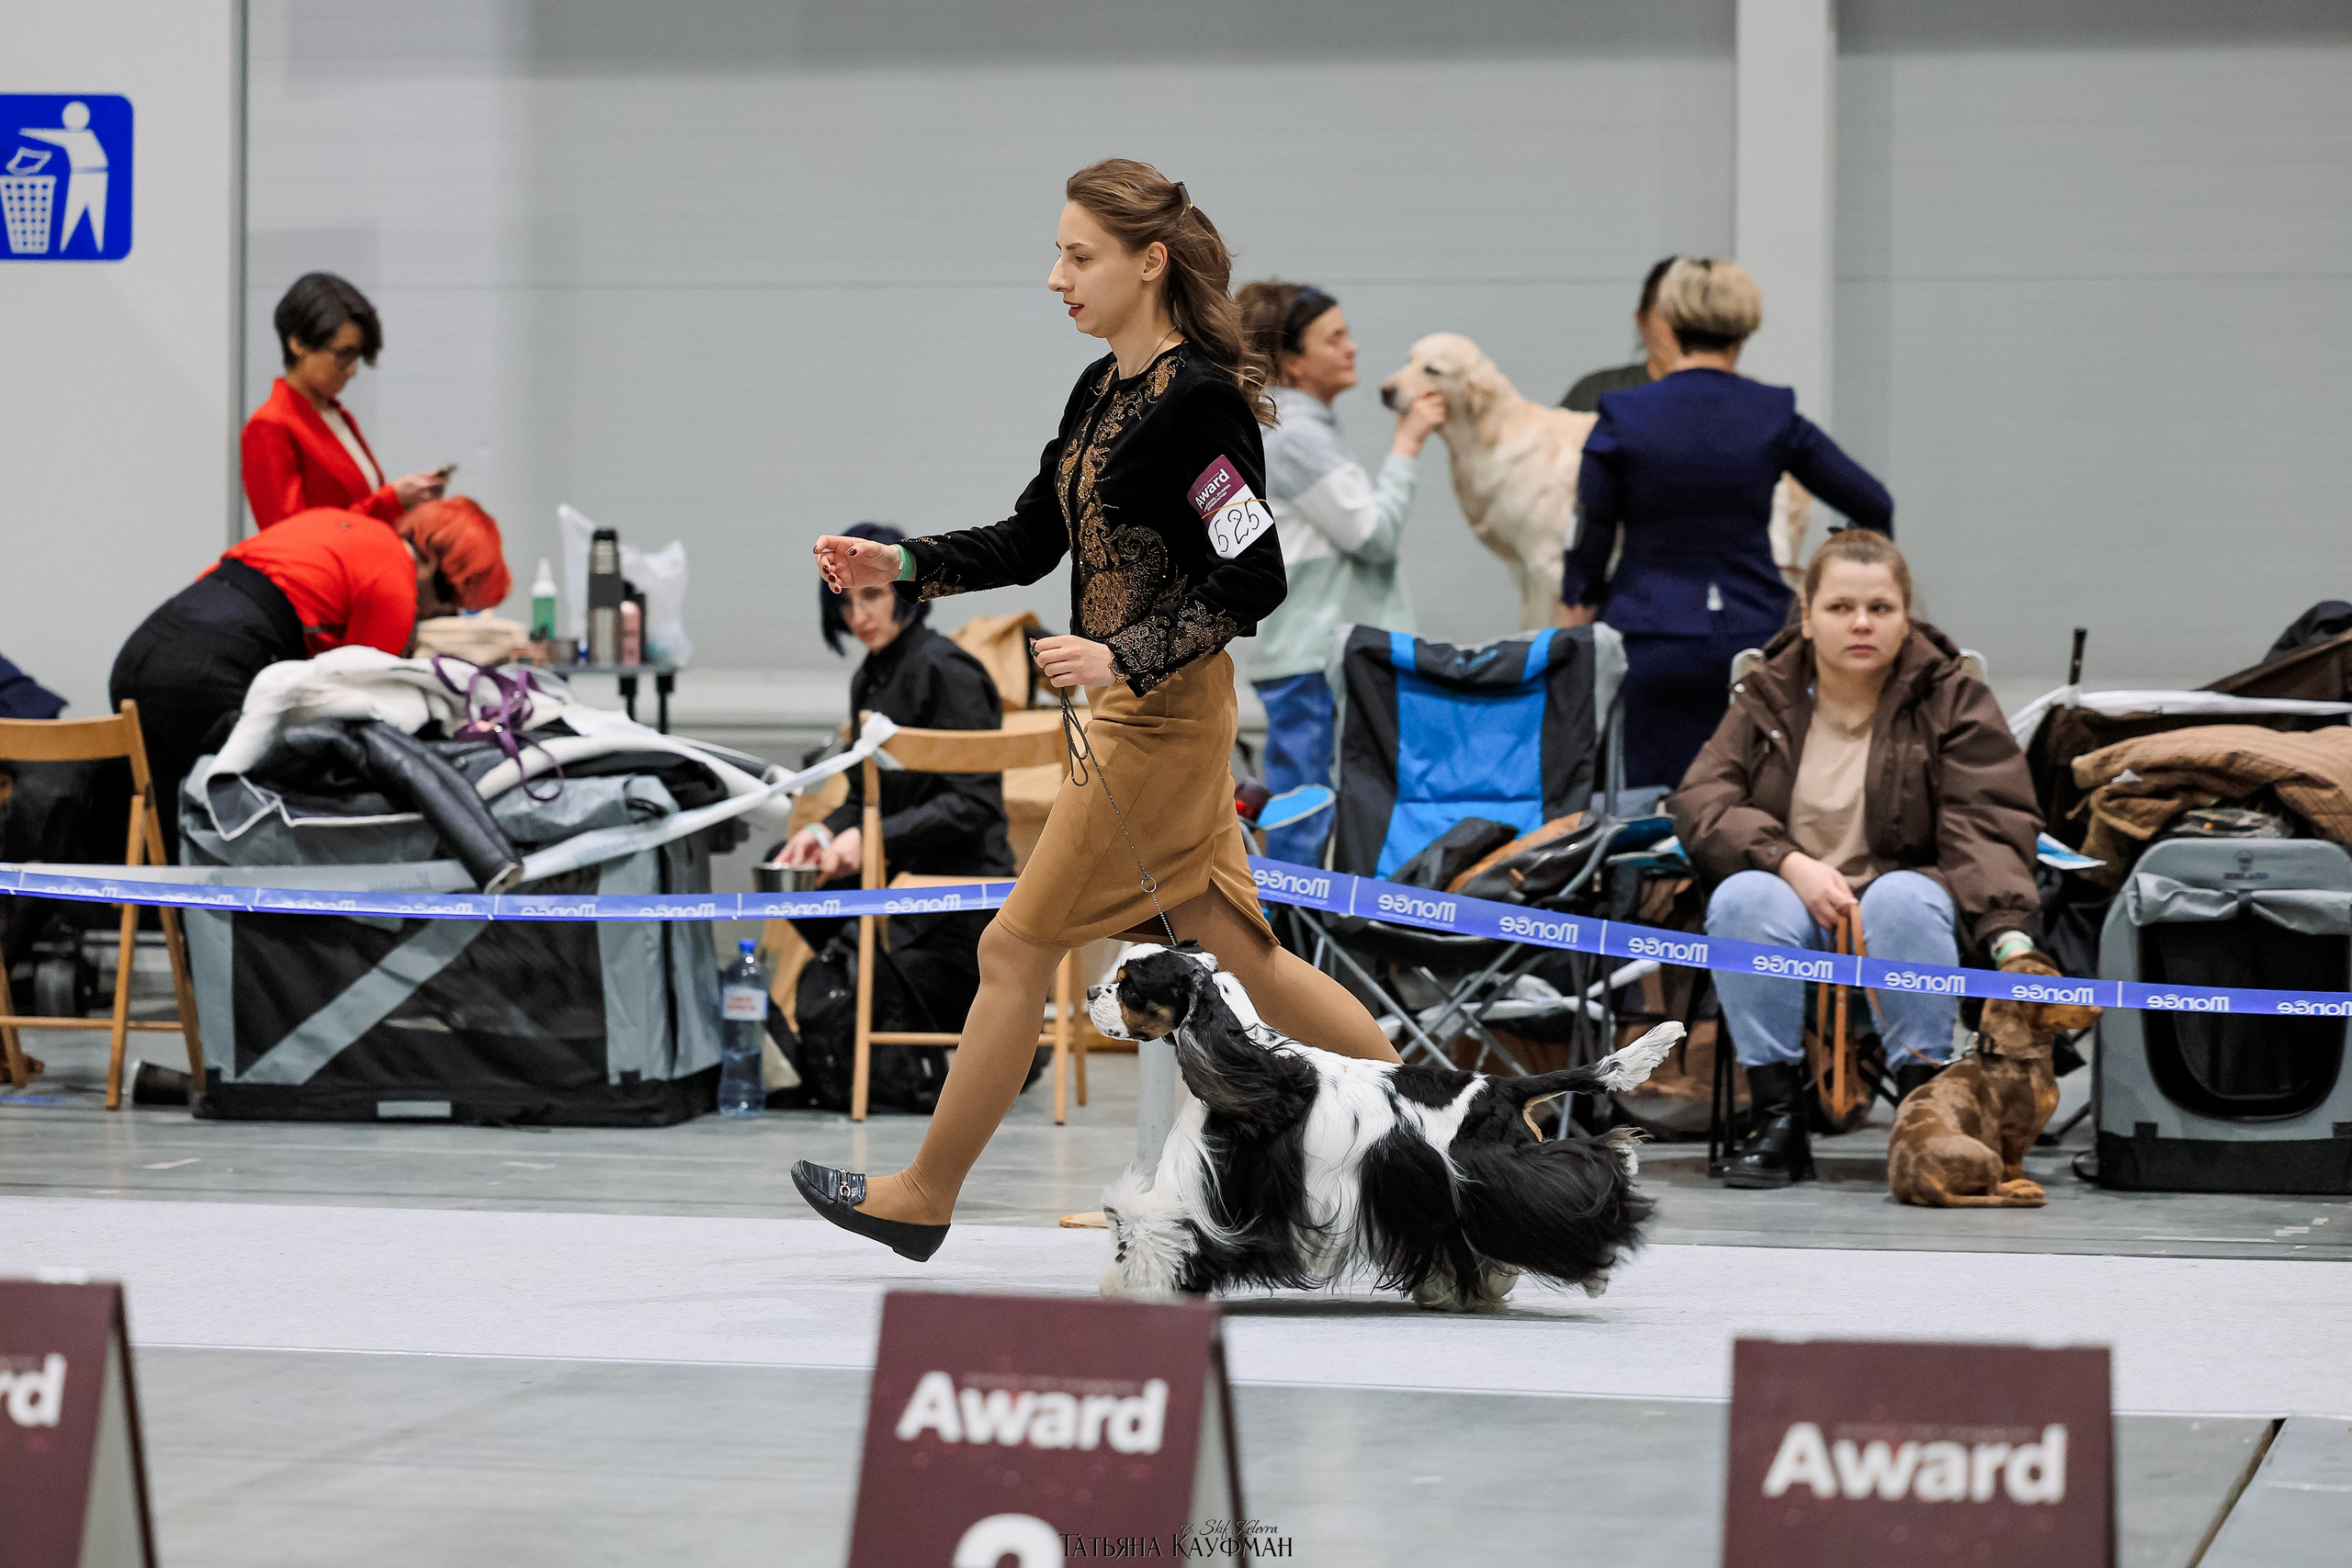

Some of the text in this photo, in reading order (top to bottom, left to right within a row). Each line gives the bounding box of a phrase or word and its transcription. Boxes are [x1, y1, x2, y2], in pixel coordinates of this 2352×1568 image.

[1194, 468, 1231, 510] Award
[1214, 497, 1260, 553] 525
[896, 1371, 1170, 1454] Award
[1761, 1420, 2069, 1506] Award
